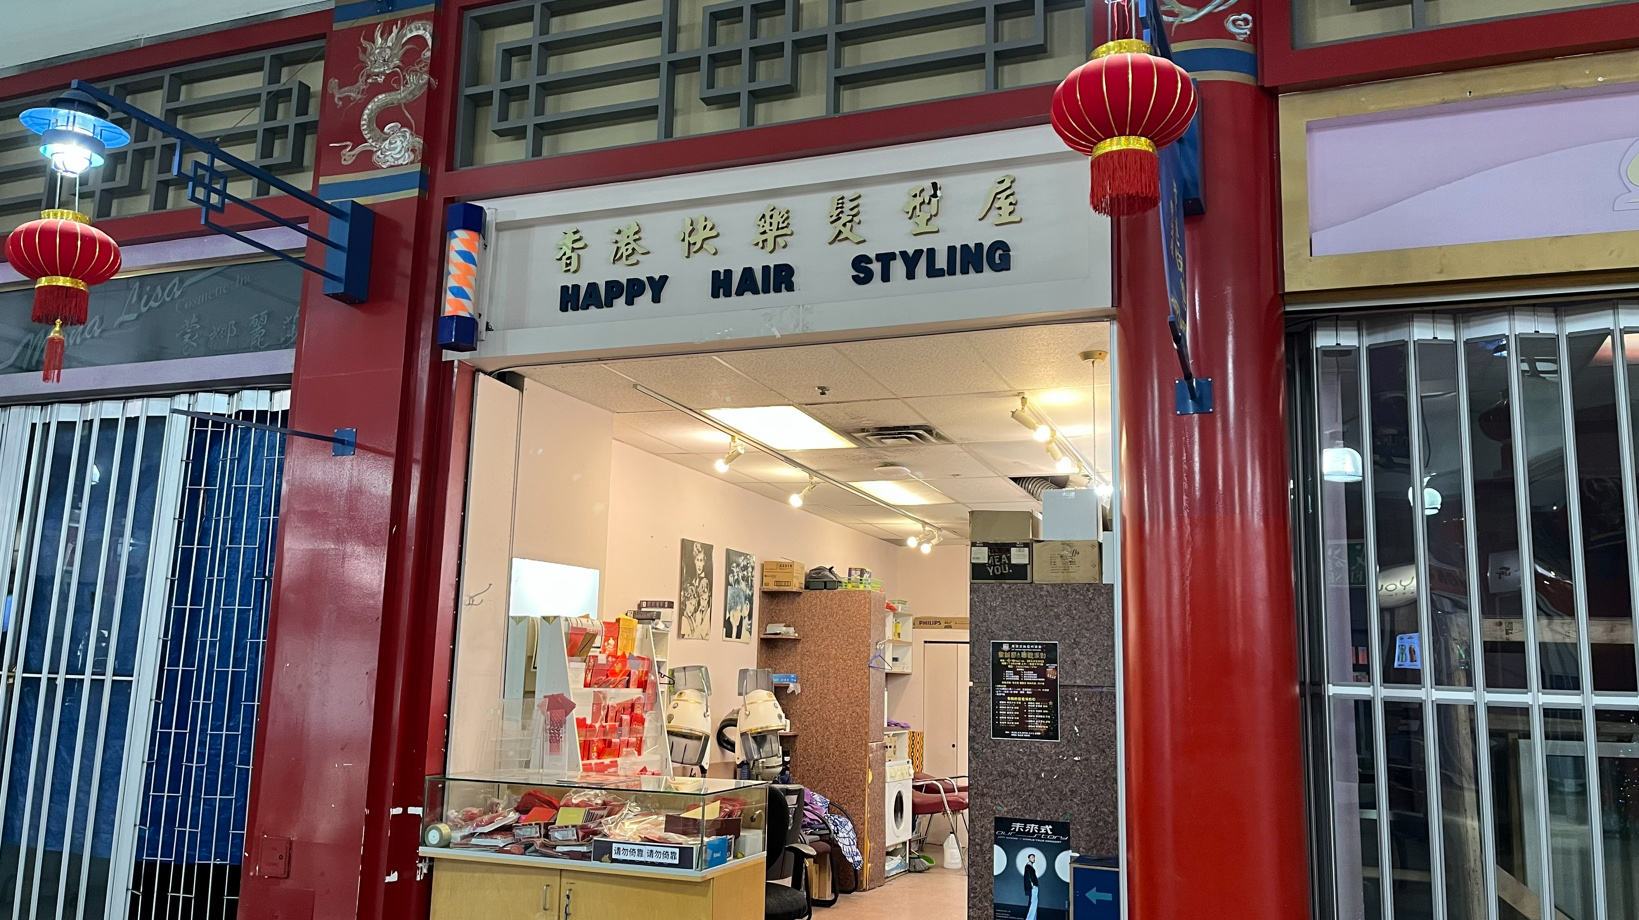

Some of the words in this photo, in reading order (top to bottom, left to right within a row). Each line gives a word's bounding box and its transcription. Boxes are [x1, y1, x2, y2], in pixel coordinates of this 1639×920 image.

[554, 174, 1024, 274] 香港快樂髮型屋
[559, 275, 669, 312] HAPPY
[711, 263, 795, 299] HAIR
[851, 239, 1012, 286] STYLING
[0, 314, 104, 370] Mna
[114, 269, 208, 326] Lisa
[986, 564, 1013, 576] YOU.
[613, 846, 644, 858] 请勿倚靠
[646, 848, 678, 861] 请勿倚靠
